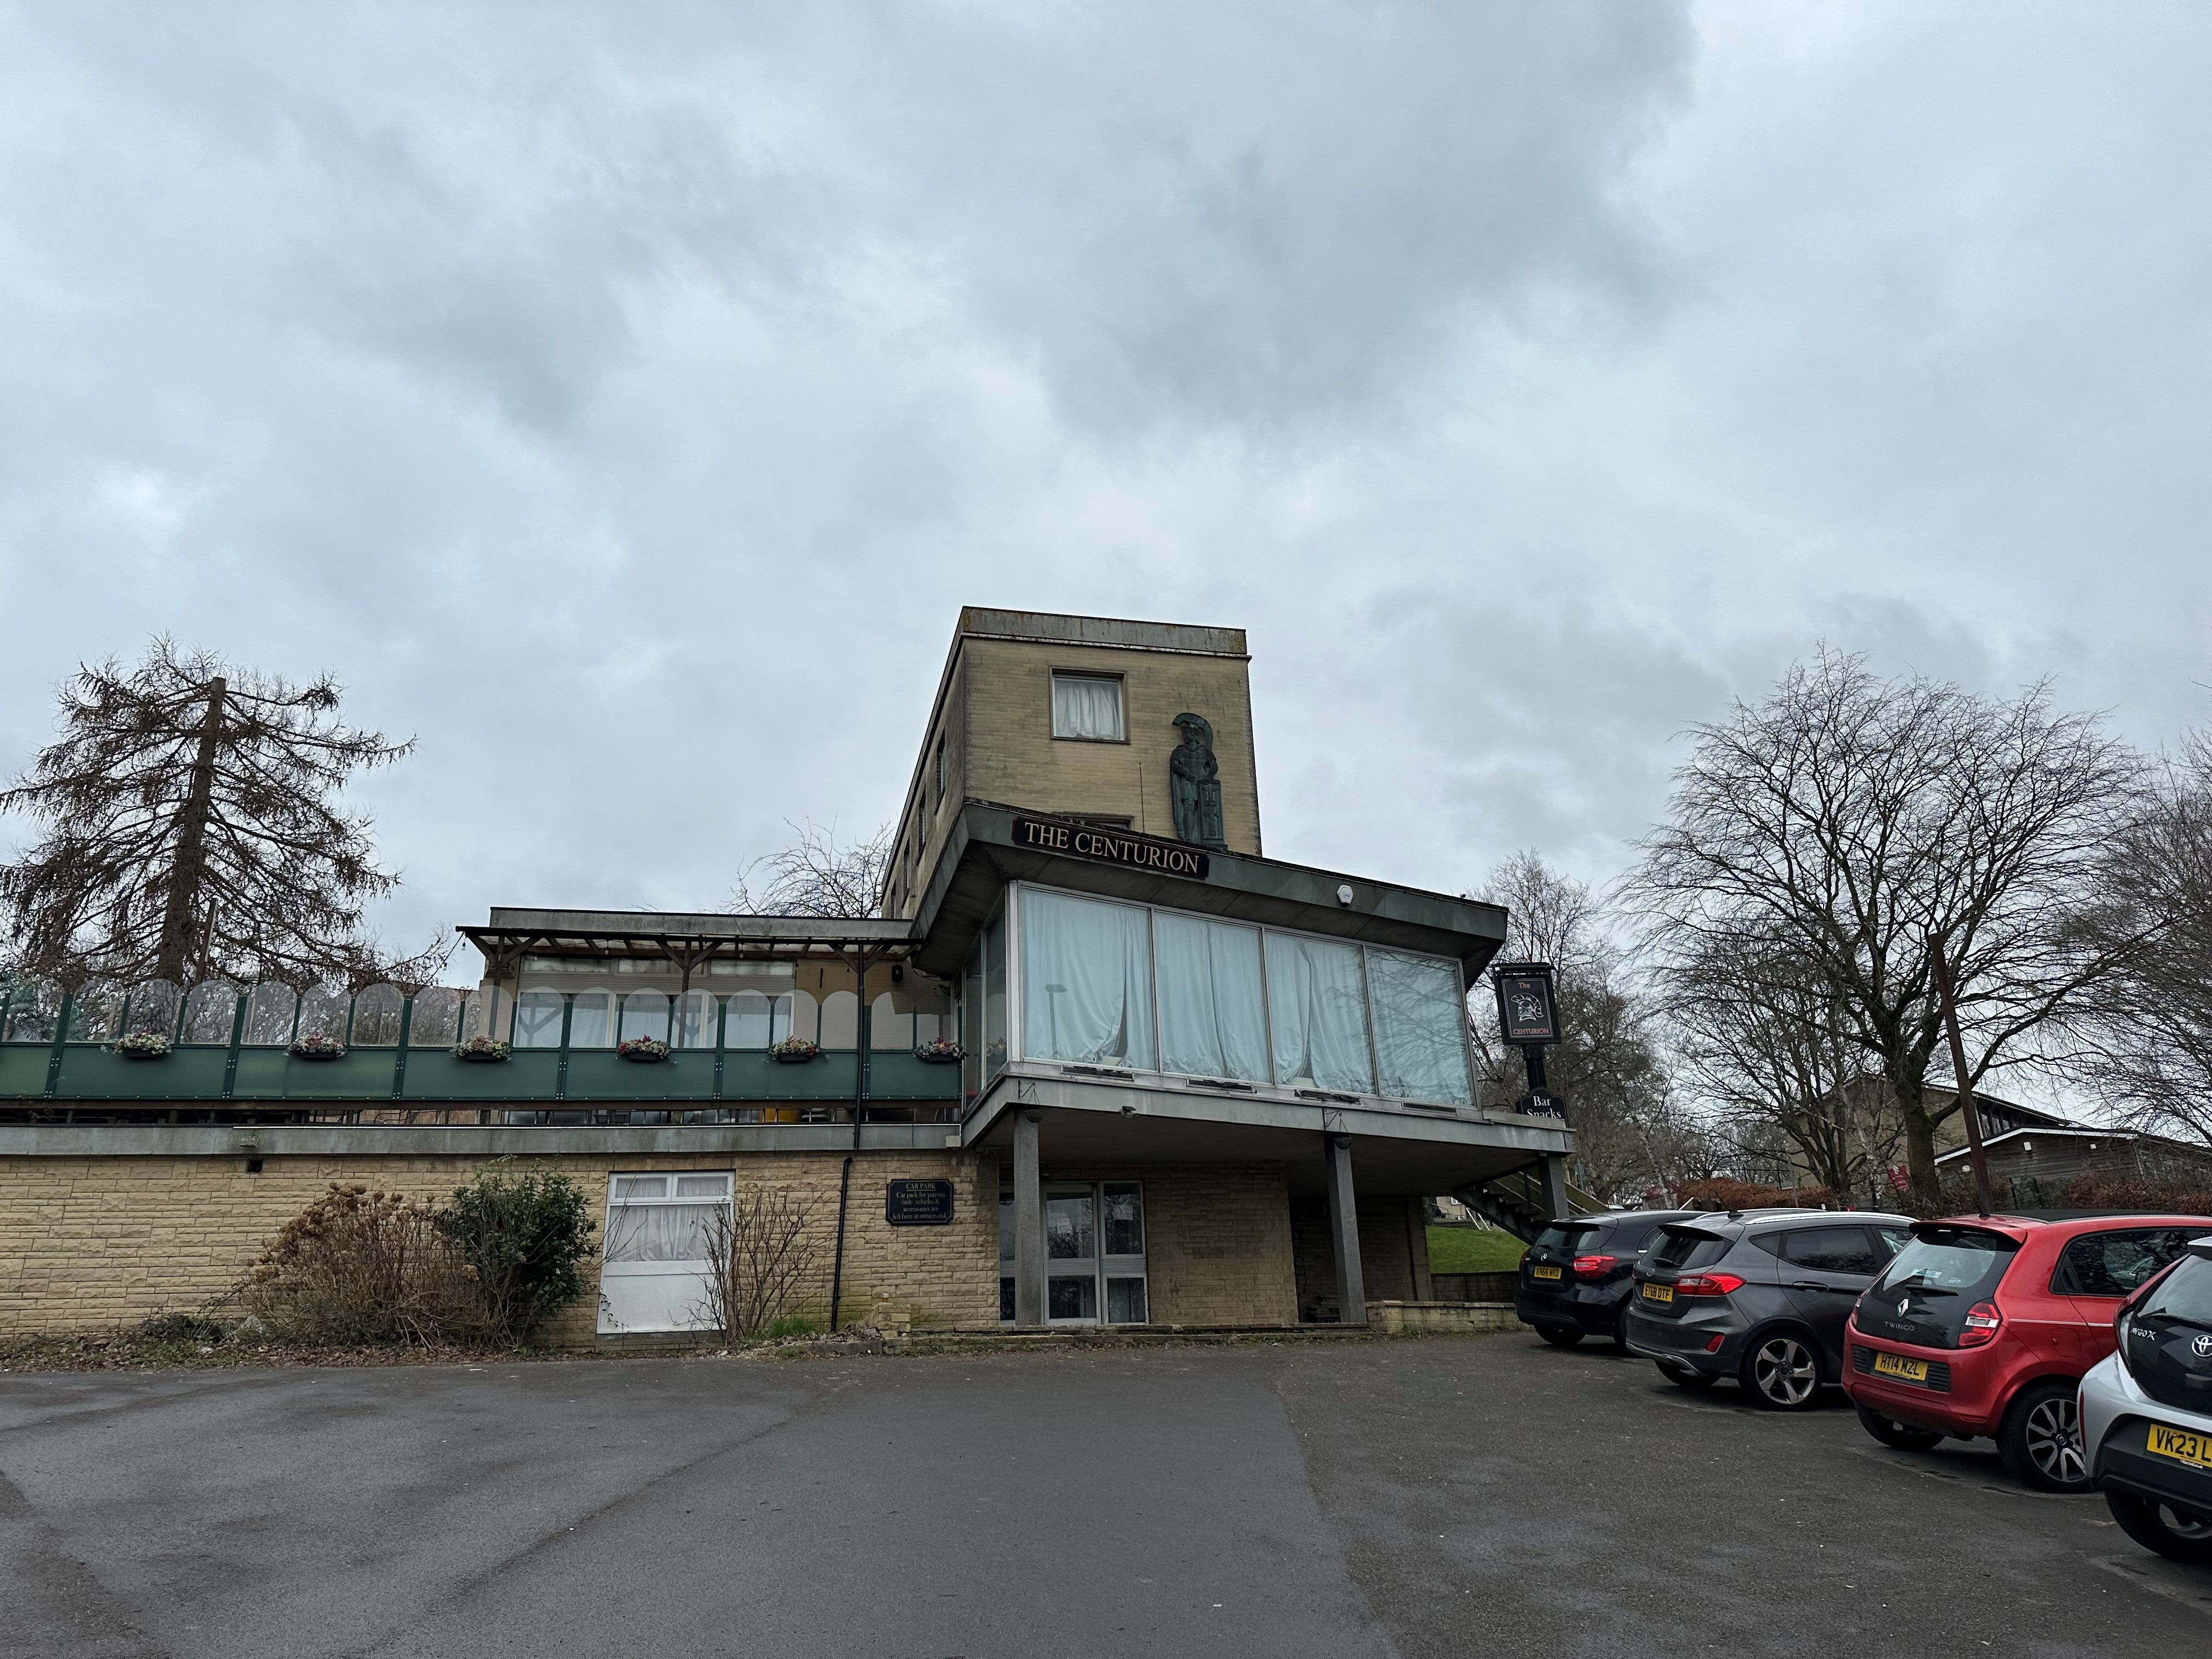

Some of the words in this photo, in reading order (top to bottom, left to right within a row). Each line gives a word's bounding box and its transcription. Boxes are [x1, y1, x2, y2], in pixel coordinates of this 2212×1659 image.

[1025, 822, 1069, 849] THE
[1075, 833, 1199, 873] CENTURION
[1532, 1096, 1551, 1107] Bar
[1645, 1285, 1657, 1297] ET68
[1657, 1288, 1670, 1300] DTF
[1884, 1321, 1915, 1331] TWINGO
[2130, 1327, 2147, 1337] AYGO
[2147, 1330, 2157, 1341] X
[1881, 1355, 1899, 1371] HT14
[1900, 1359, 1918, 1376] MZL
[2157, 1428, 2198, 1458] VK23
